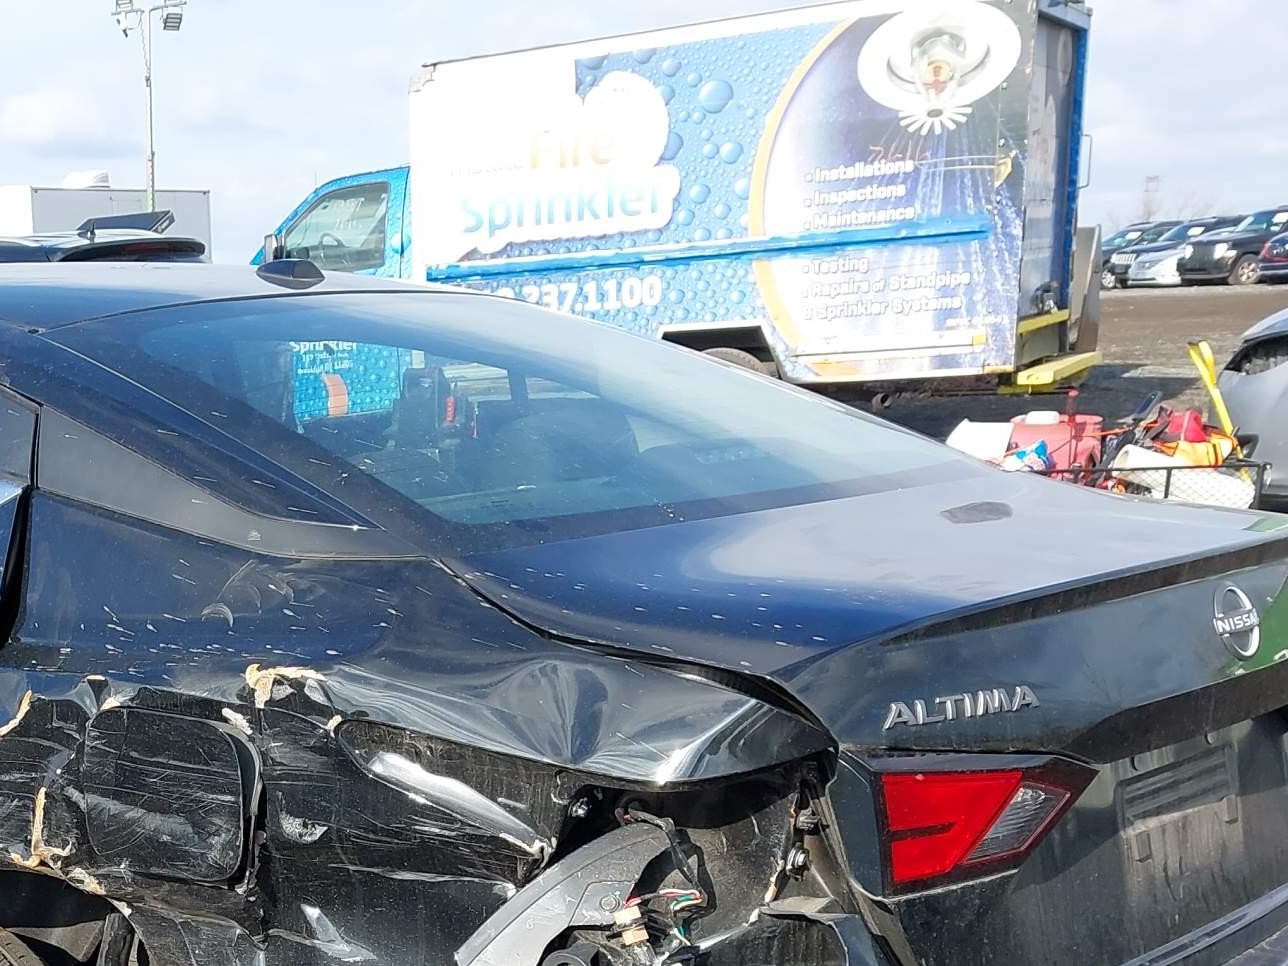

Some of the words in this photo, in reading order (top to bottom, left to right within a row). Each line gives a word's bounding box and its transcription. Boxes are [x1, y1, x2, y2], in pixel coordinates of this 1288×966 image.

[815, 159, 914, 183] Installations
[460, 176, 660, 238] Sprinkler
[814, 184, 906, 206] Inspections
[813, 206, 915, 229] Maintenance
[812, 256, 869, 274] Testing
[812, 278, 870, 299] Repairs
[872, 278, 886, 292] of
[889, 271, 970, 291] Standpipe
[816, 301, 889, 322] Sprinkler
[893, 296, 962, 316] Systems
[1217, 612, 1259, 633] NISSA
[882, 685, 1041, 731] ALTIMA
